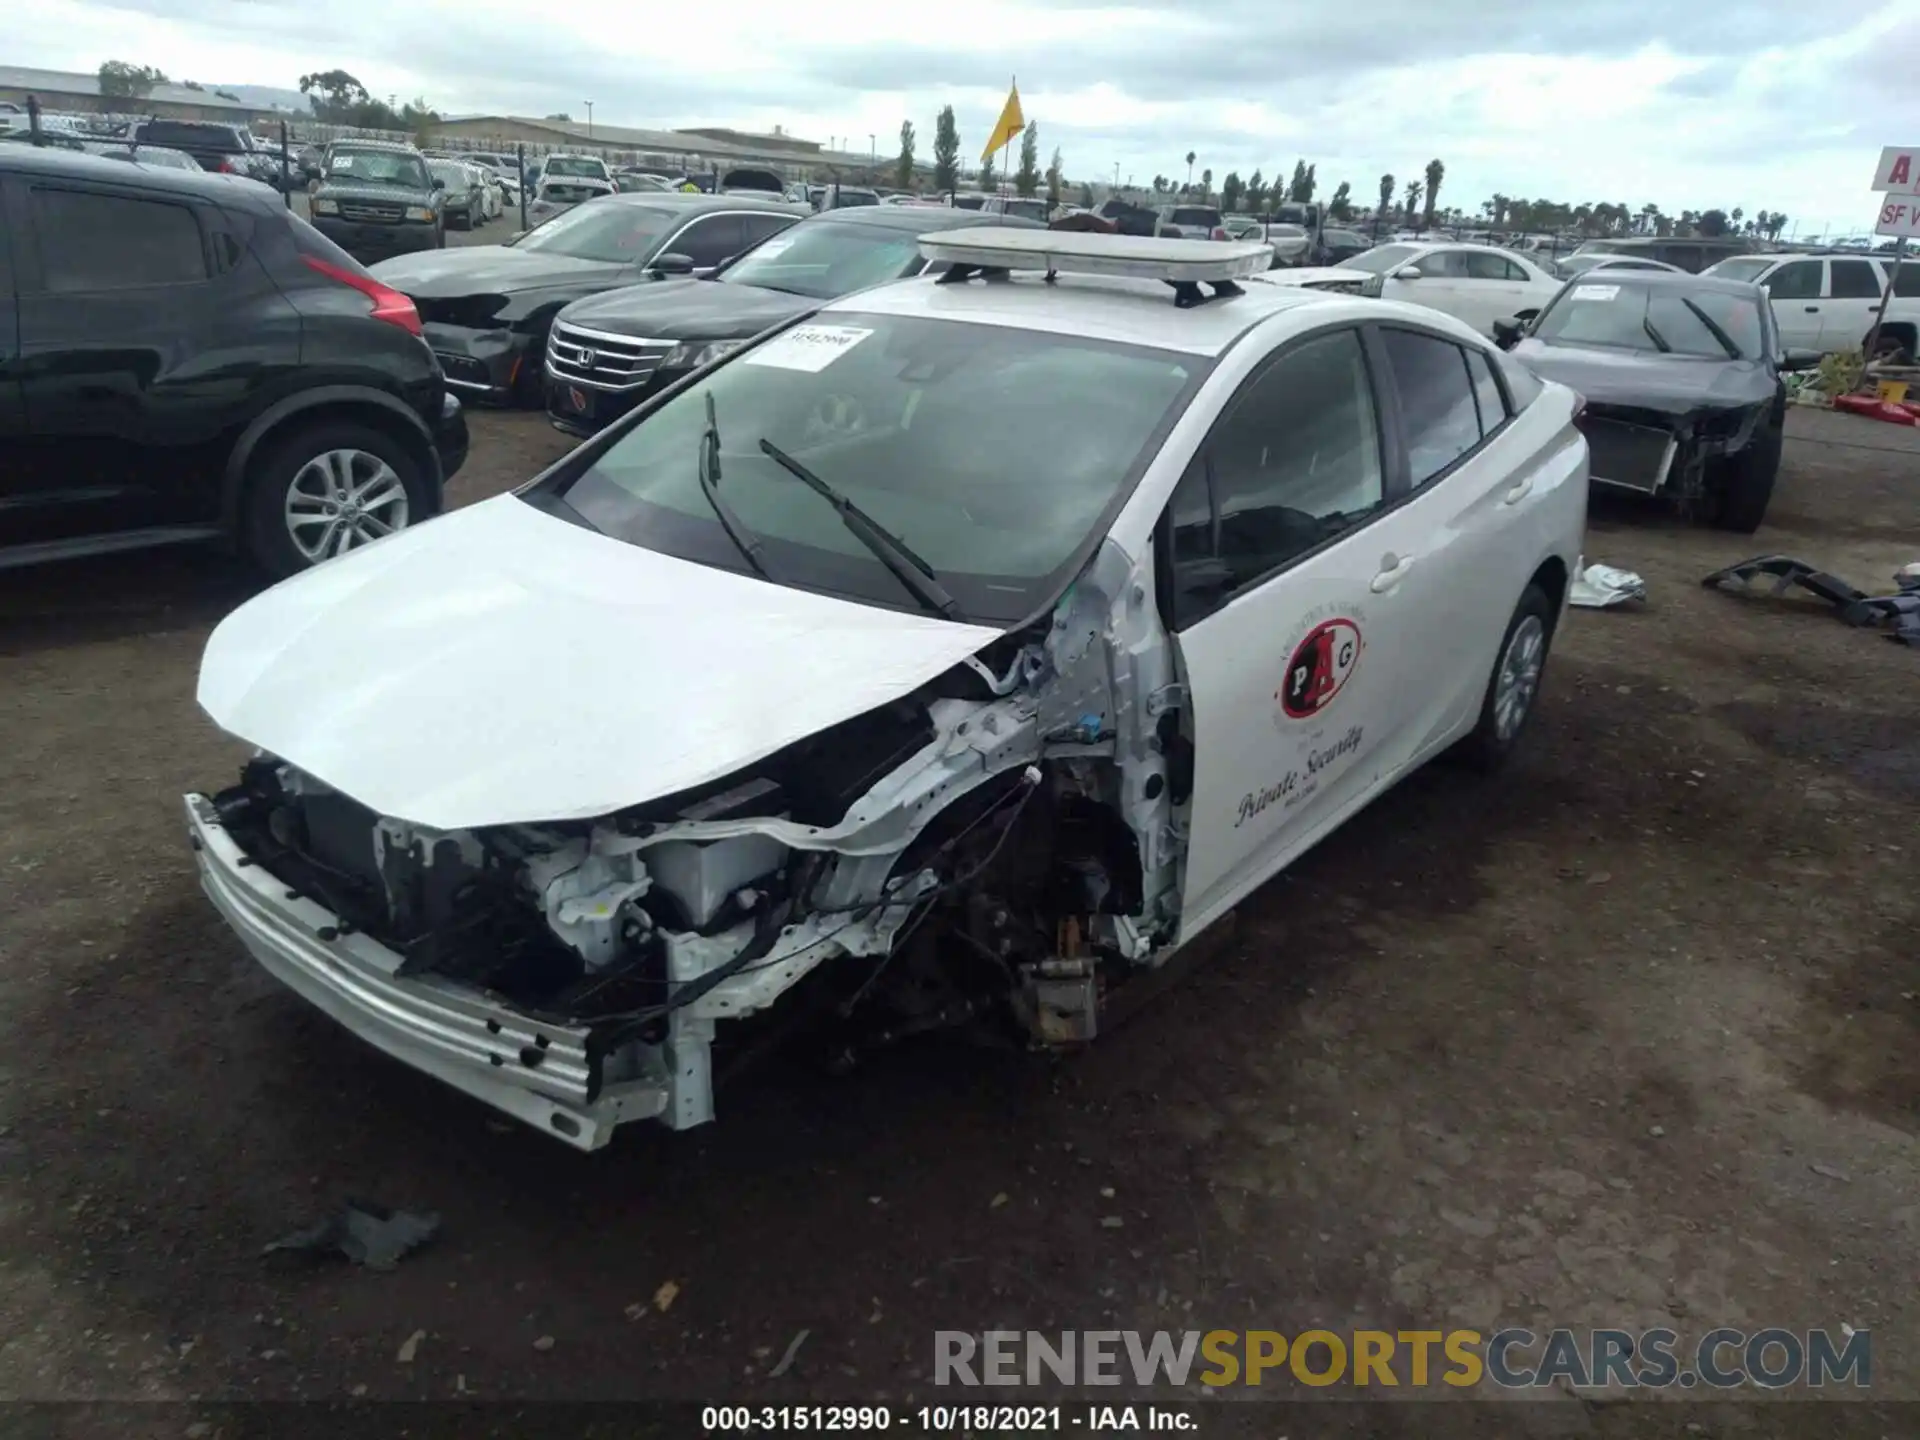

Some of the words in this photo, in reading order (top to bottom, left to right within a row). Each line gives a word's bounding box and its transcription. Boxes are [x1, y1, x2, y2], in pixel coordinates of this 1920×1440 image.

[1887, 155, 1912, 184] A
[1881, 204, 1907, 225] SF
[1233, 771, 1298, 828] Private
[1302, 724, 1365, 781] Security
